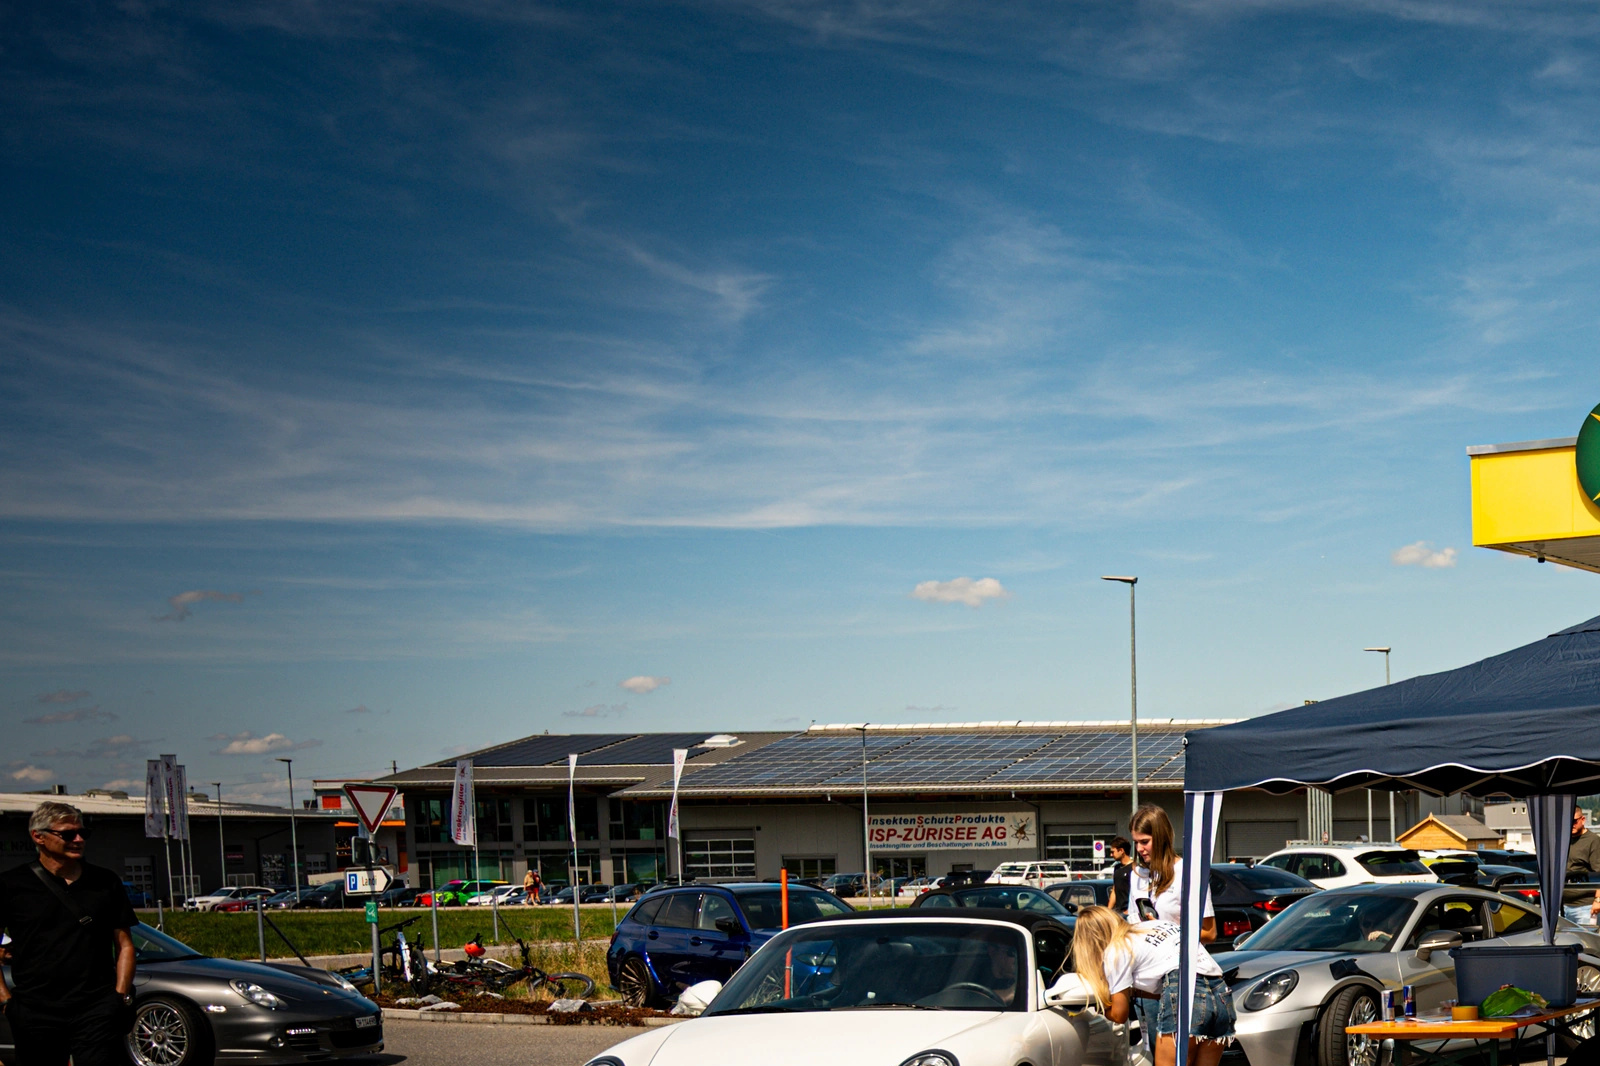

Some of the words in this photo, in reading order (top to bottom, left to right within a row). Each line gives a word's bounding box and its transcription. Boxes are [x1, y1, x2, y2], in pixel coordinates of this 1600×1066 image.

[868, 815, 1006, 826] InsektenSchutzProdukte
[869, 825, 978, 842] ISP-ZÜRISEE
[981, 827, 1008, 840] AG
[927, 841, 974, 850] Beschattungen
[991, 840, 1008, 848] Mass
